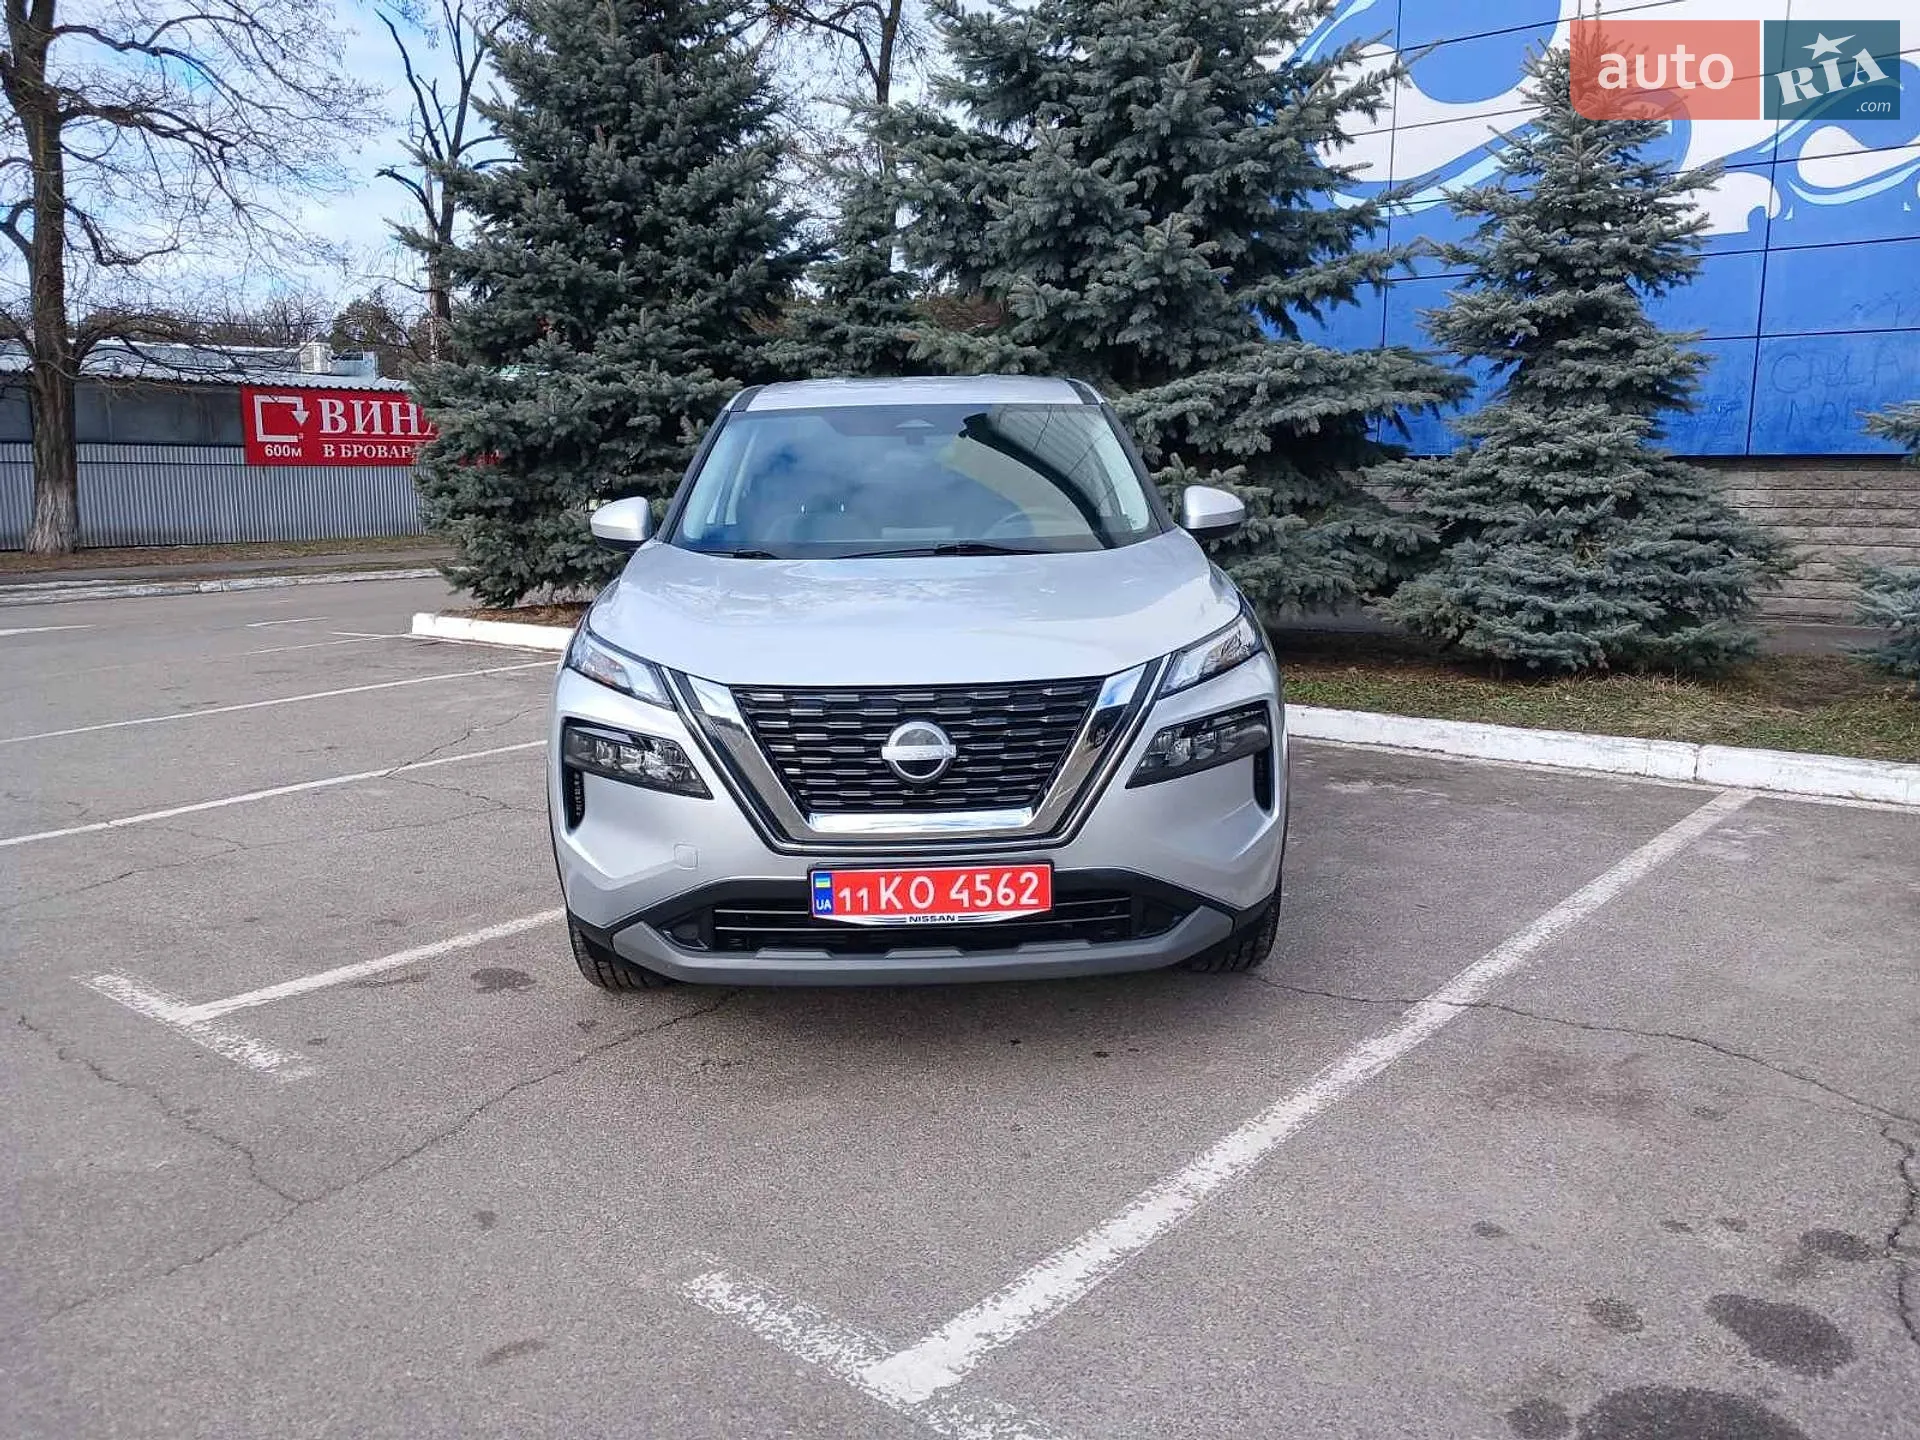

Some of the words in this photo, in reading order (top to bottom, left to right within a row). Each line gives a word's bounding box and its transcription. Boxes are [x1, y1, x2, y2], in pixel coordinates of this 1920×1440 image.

[317, 398, 434, 436] ВИН
[323, 444, 335, 458] В
[341, 444, 417, 459] БРОВАР
[949, 871, 1040, 908] 4562
[816, 900, 832, 910] UA
[908, 914, 956, 923] NISSAN
